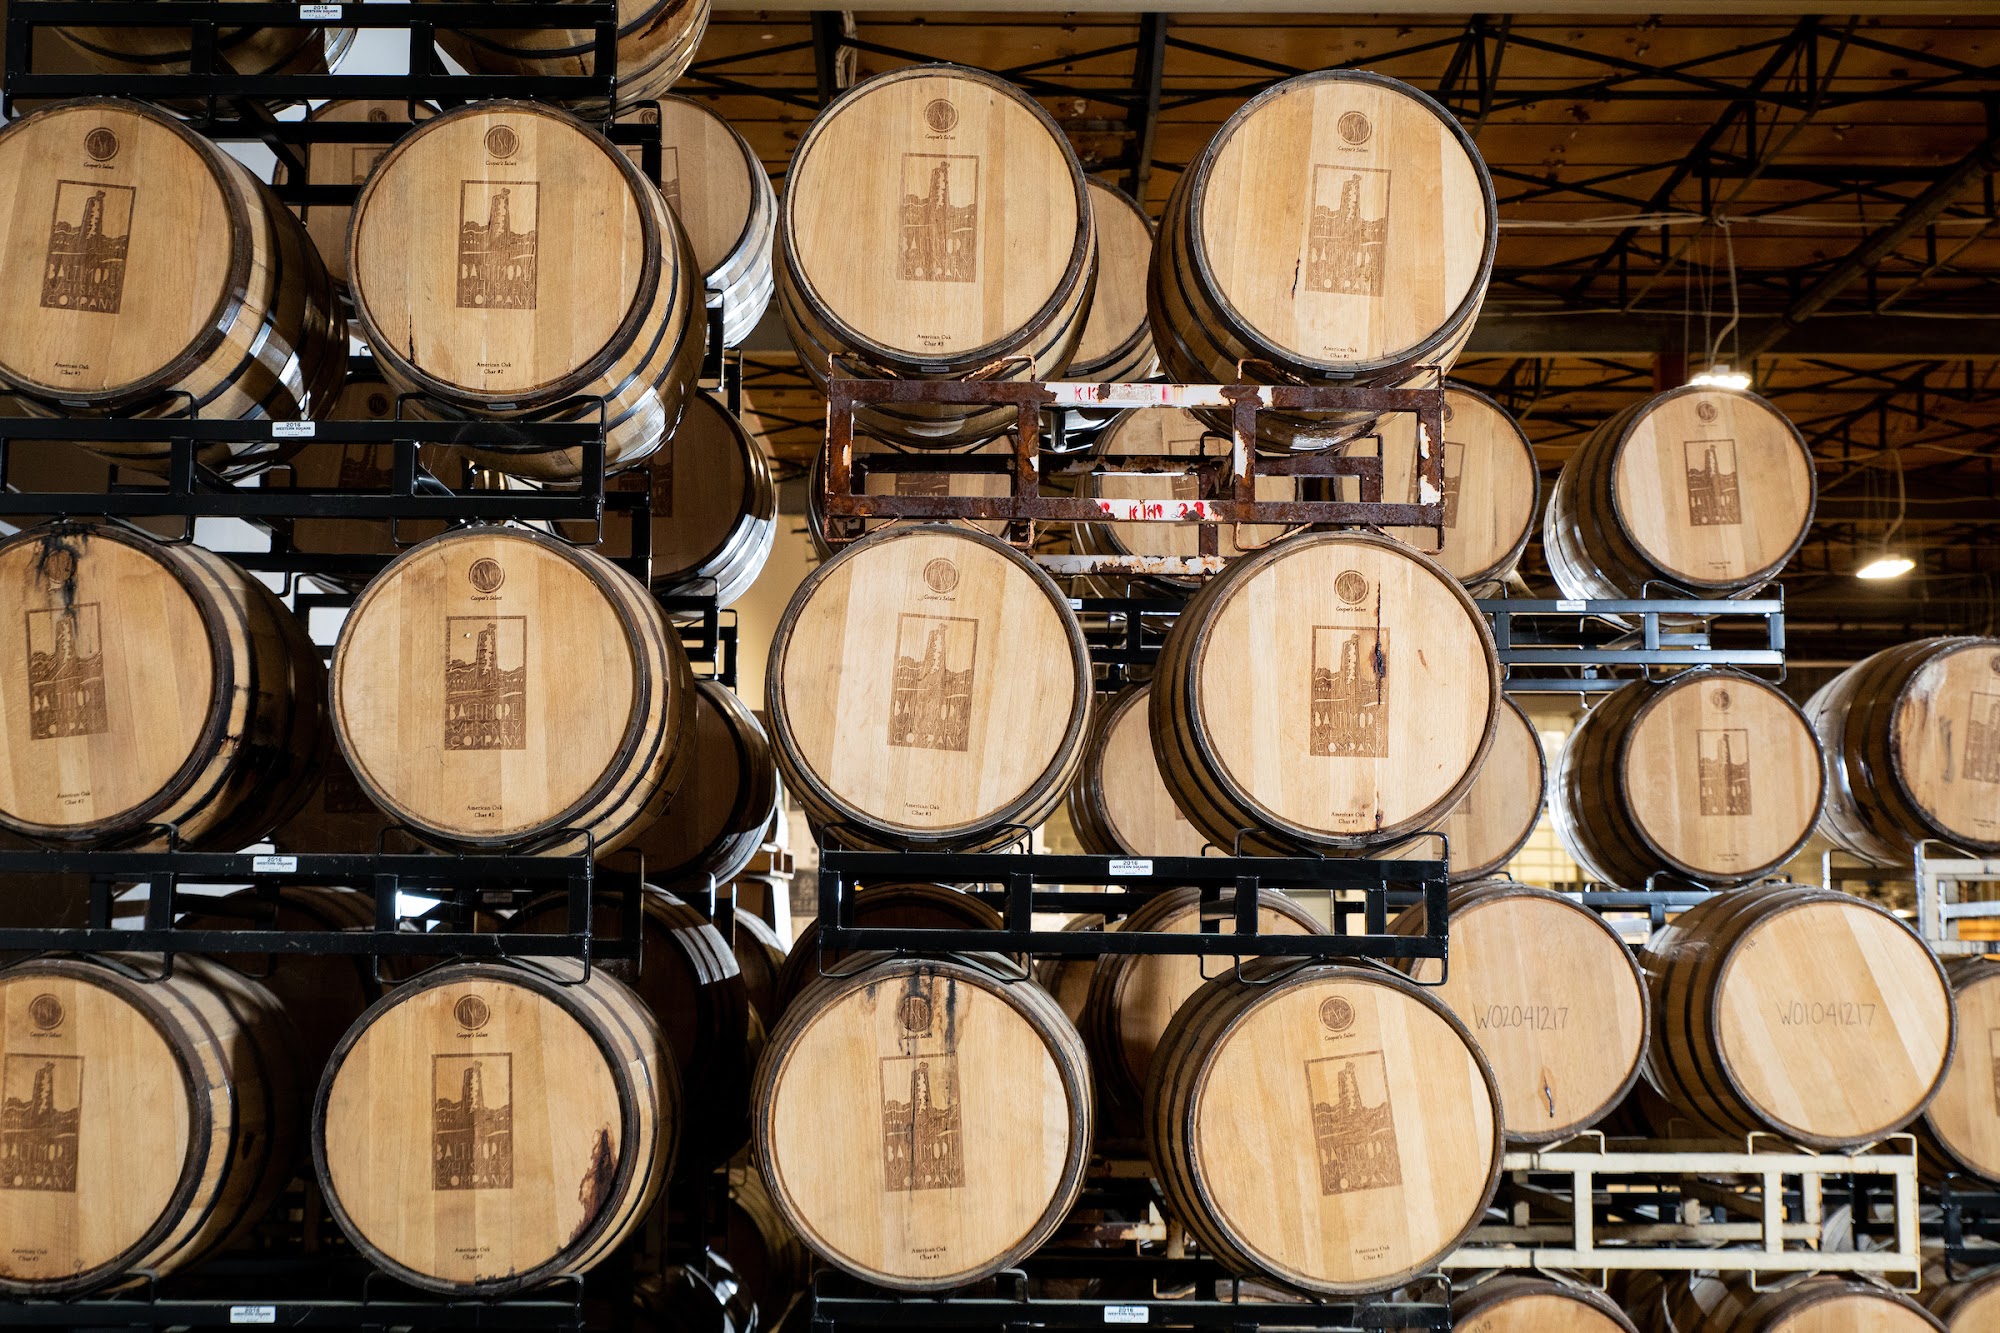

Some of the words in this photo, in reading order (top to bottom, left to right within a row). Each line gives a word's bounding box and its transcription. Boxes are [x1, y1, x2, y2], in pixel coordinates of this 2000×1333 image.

[925, 133, 943, 142] Cooper's
[944, 133, 956, 141] Select
[1338, 145, 1355, 153] Cooper's
[84, 161, 102, 170] Cooper's
[102, 162, 115, 170] Select
[486, 160, 503, 168] Cooper's
[49, 283, 119, 298] WHISKEY
[46, 295, 118, 310] COMPANY
[462, 294, 533, 306] COMPANY
[1322, 345, 1346, 353] American
[54, 362, 77, 370] American
[925, 593, 943, 602] Cooper's
[1336, 606, 1354, 614] Cooper's
[449, 702, 520, 721] BALTIMORE
[451, 721, 521, 735] WHISKEY
[450, 735, 521, 748] COMPANY
[893, 732, 965, 748] COMPANY
[1316, 741, 1385, 754] COMPANY
[905, 802, 928, 810] American
[31, 1031, 49, 1039] Cooper's
[456, 1031, 474, 1040] Cooper's
[1324, 1034, 1342, 1042] Cooper's
[1343, 1032, 1356, 1040] Select
[436, 1141, 507, 1161] BALTIMORE
[440, 1159, 510, 1174] WHISKEY
[1, 1174, 73, 1189] COMPANY
[437, 1174, 510, 1188] COMPANY
[891, 1173, 961, 1189] COMPANY
[1354, 1246, 1377, 1254] American
